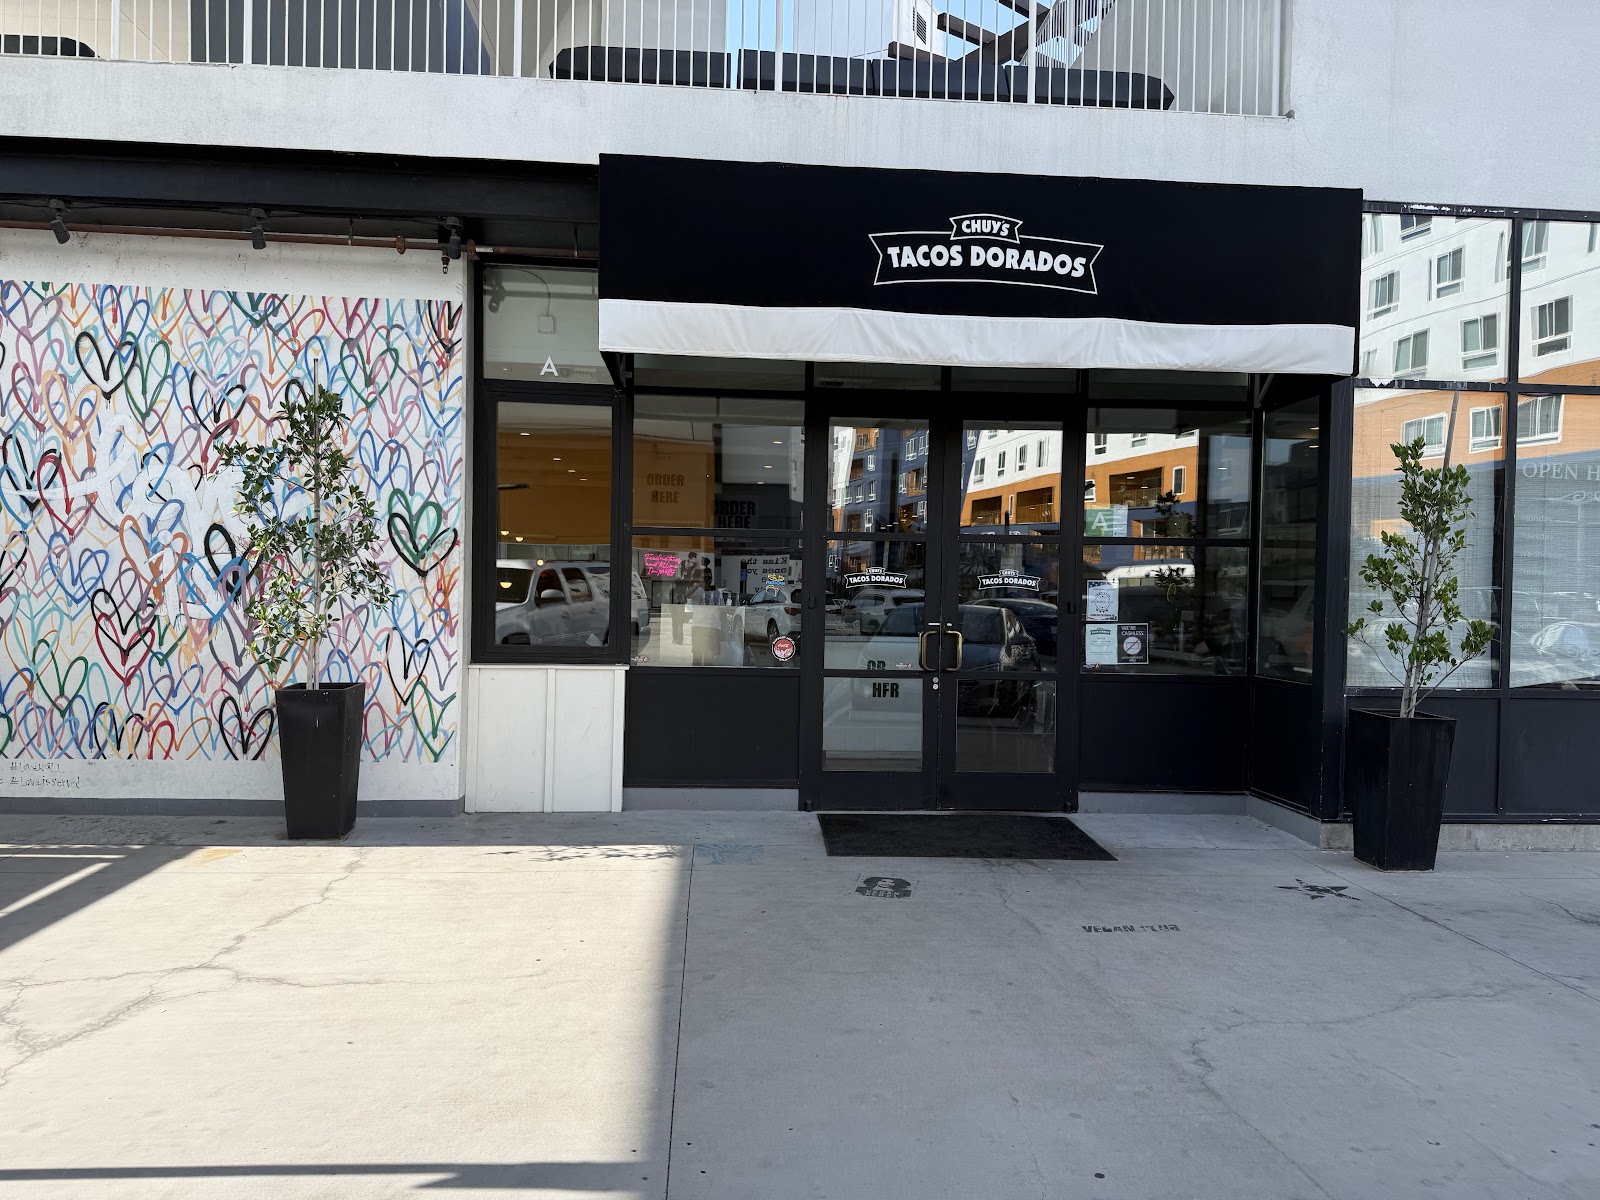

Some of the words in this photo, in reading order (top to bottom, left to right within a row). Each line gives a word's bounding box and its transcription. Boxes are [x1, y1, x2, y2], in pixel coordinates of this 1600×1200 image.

[961, 219, 1010, 237] CHUY'S
[887, 244, 964, 268] TACOS
[970, 245, 1087, 278] DORADOS
[539, 355, 559, 377] A
[1522, 461, 1578, 480] OPEN
[646, 472, 685, 487] ORDER
[651, 490, 679, 503] HERE
[1091, 511, 1109, 530] A
[849, 575, 870, 584] TACOS
[870, 575, 904, 584] DORADOS
[982, 577, 1003, 585] TACOS
[1004, 577, 1037, 587] DORADOS
[1081, 924, 1135, 933] VEGAN
